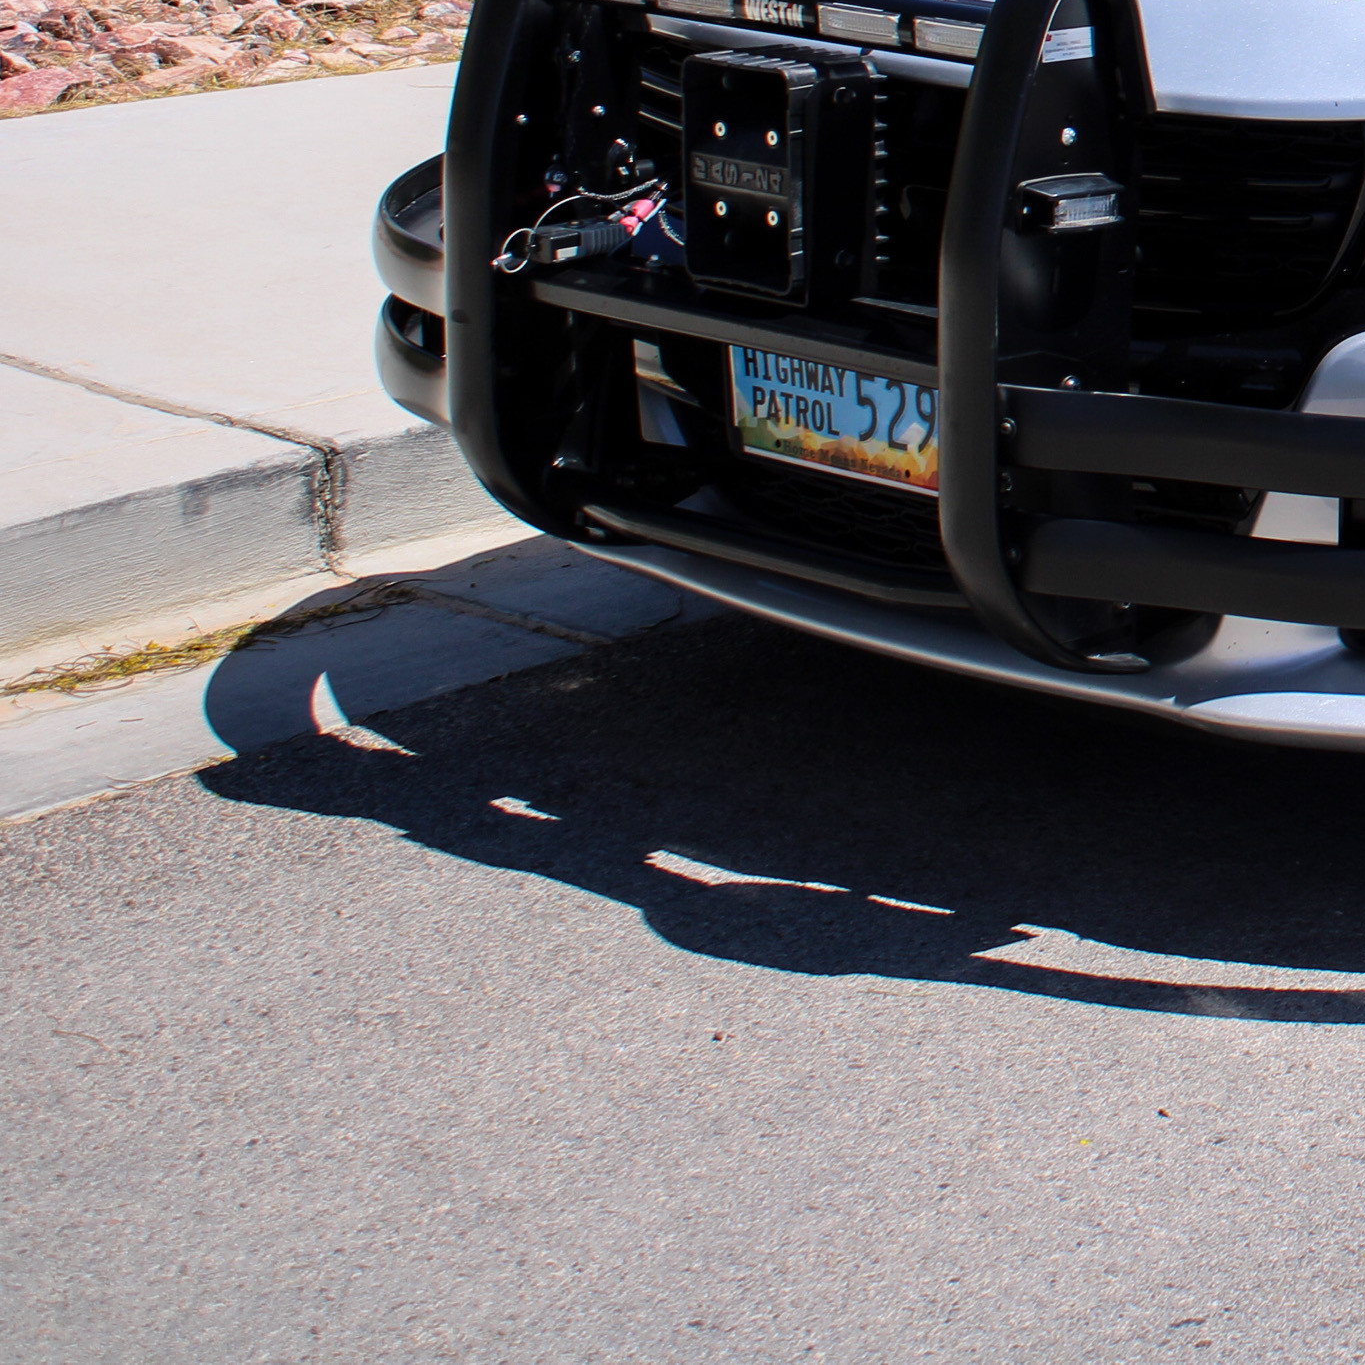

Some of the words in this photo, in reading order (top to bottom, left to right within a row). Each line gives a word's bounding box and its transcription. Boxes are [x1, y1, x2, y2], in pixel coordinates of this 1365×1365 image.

[743, 347, 848, 397] HIGHWAY
[753, 386, 840, 436] PATROL
[855, 372, 937, 453] 529
